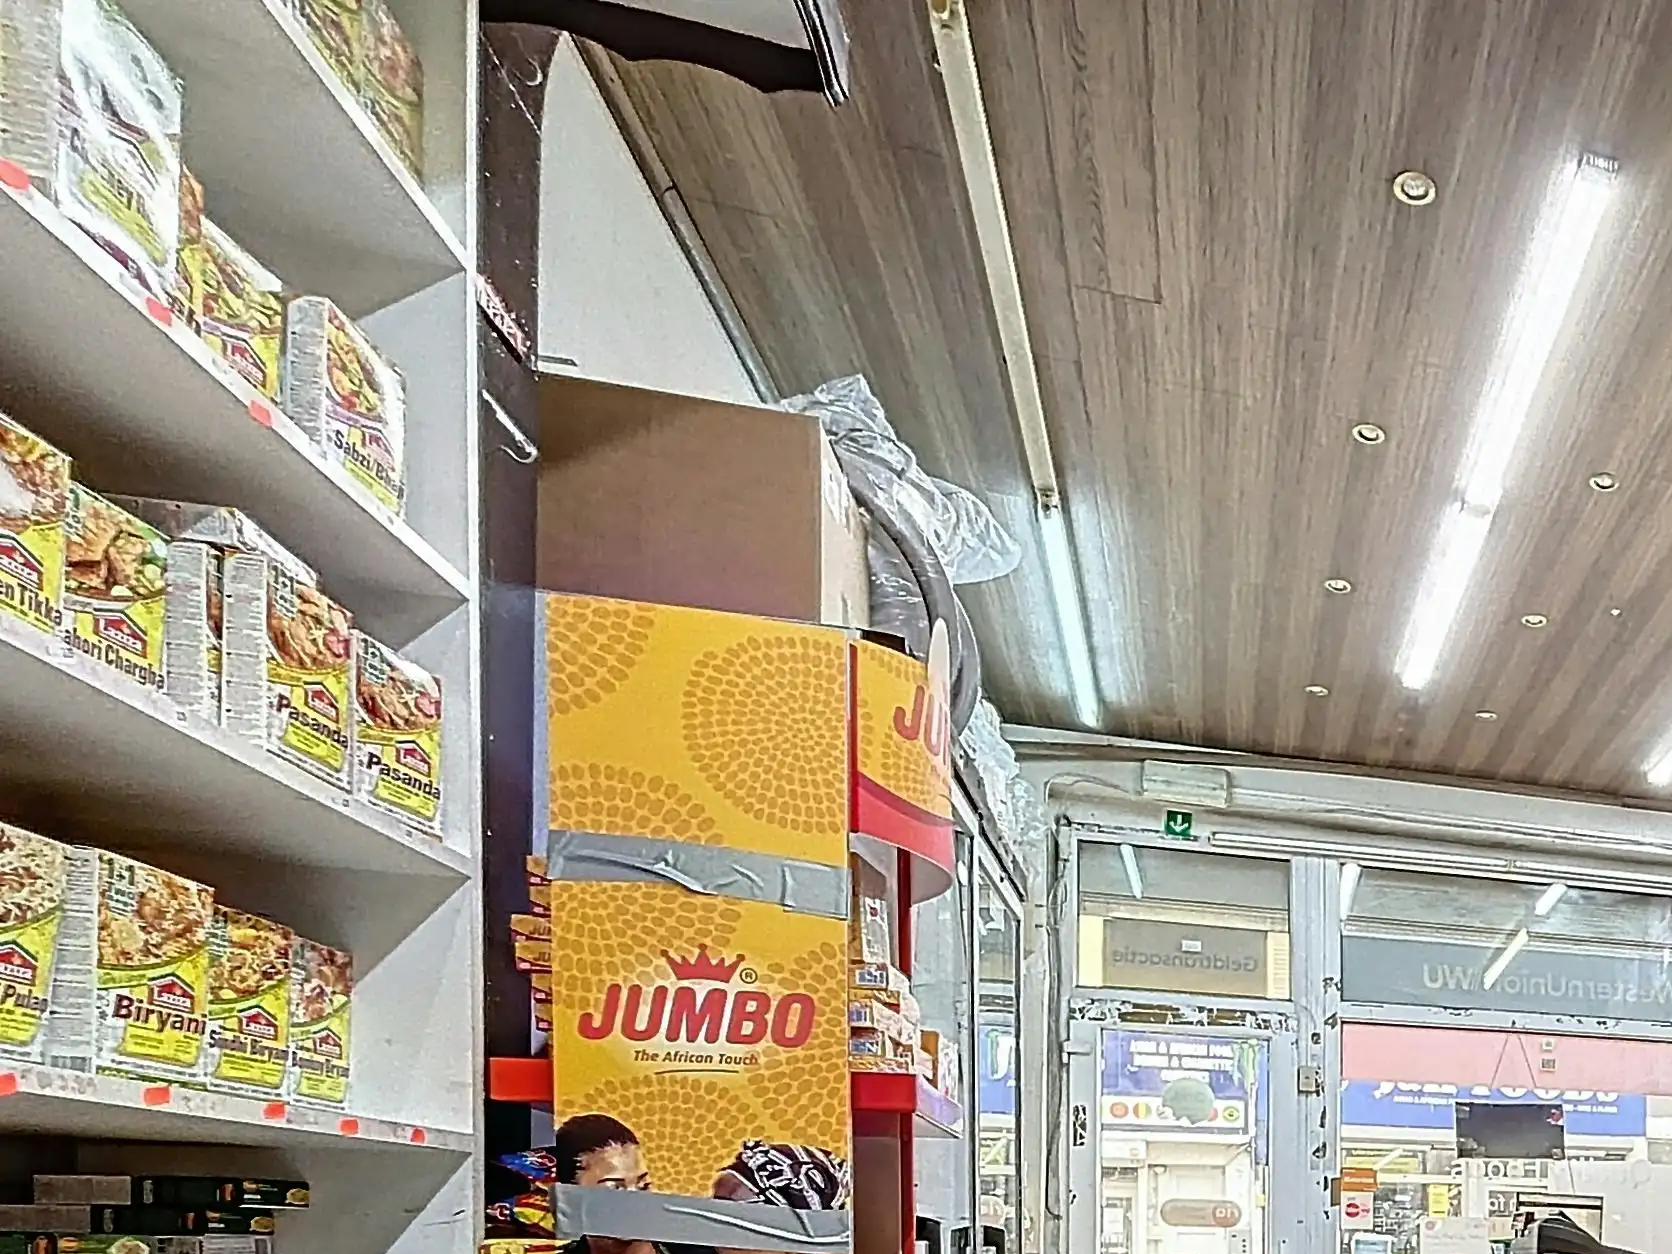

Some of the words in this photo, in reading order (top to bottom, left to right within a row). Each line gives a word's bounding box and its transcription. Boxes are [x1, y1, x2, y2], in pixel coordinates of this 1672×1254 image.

[275, 691, 350, 750] Pasanda
[365, 750, 442, 801] Pasanda
[113, 992, 207, 1035] Biryani
[577, 983, 816, 1049] JUMBO
[633, 1048, 662, 1065] The
[663, 1049, 714, 1066] African
[715, 1050, 760, 1067] Touch
